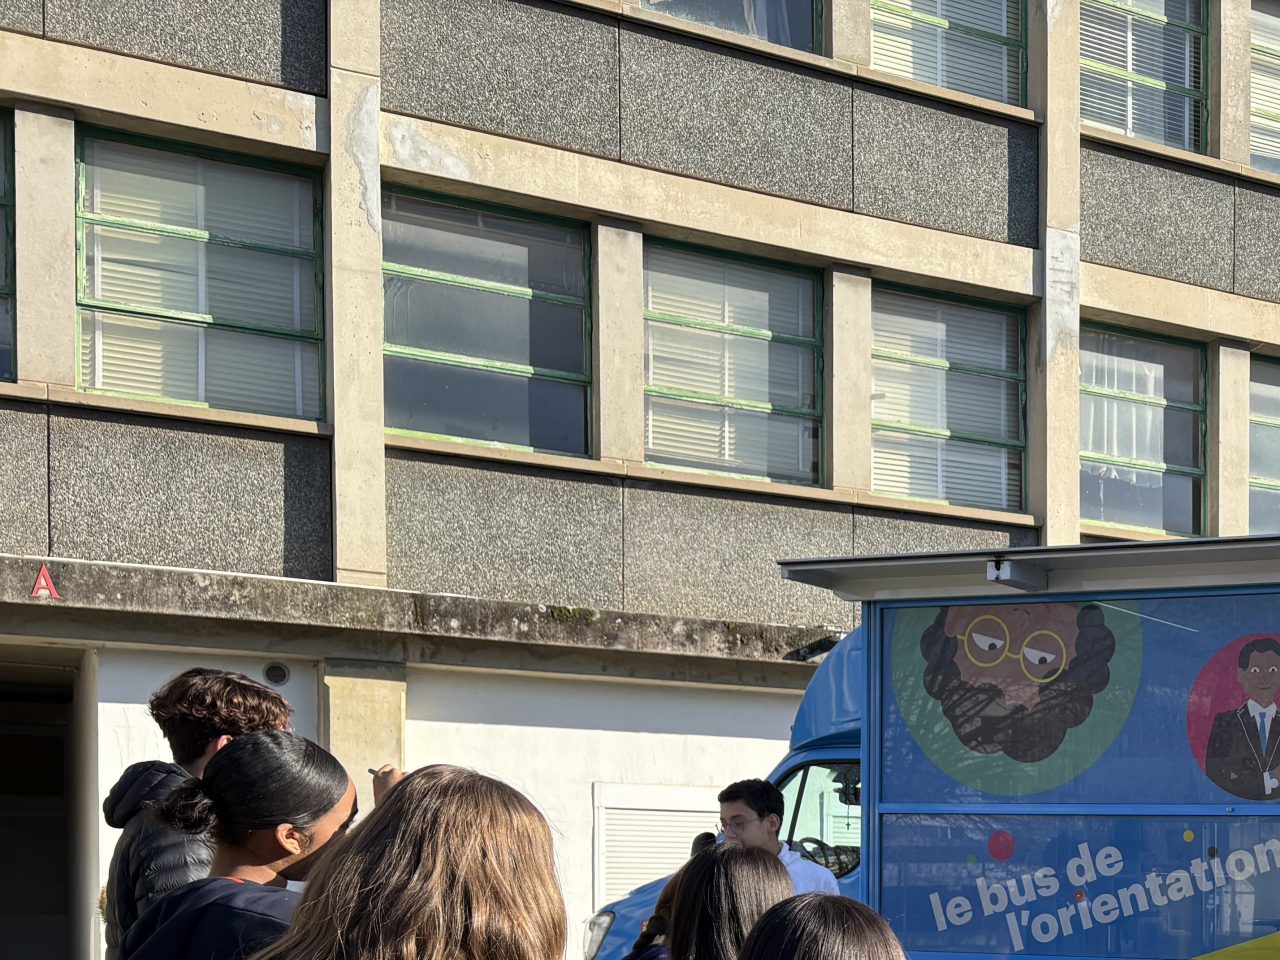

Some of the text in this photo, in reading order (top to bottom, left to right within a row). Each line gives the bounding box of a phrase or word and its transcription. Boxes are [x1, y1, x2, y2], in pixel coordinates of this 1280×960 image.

[31, 562, 63, 600] A
[929, 841, 1124, 932] le bus de
